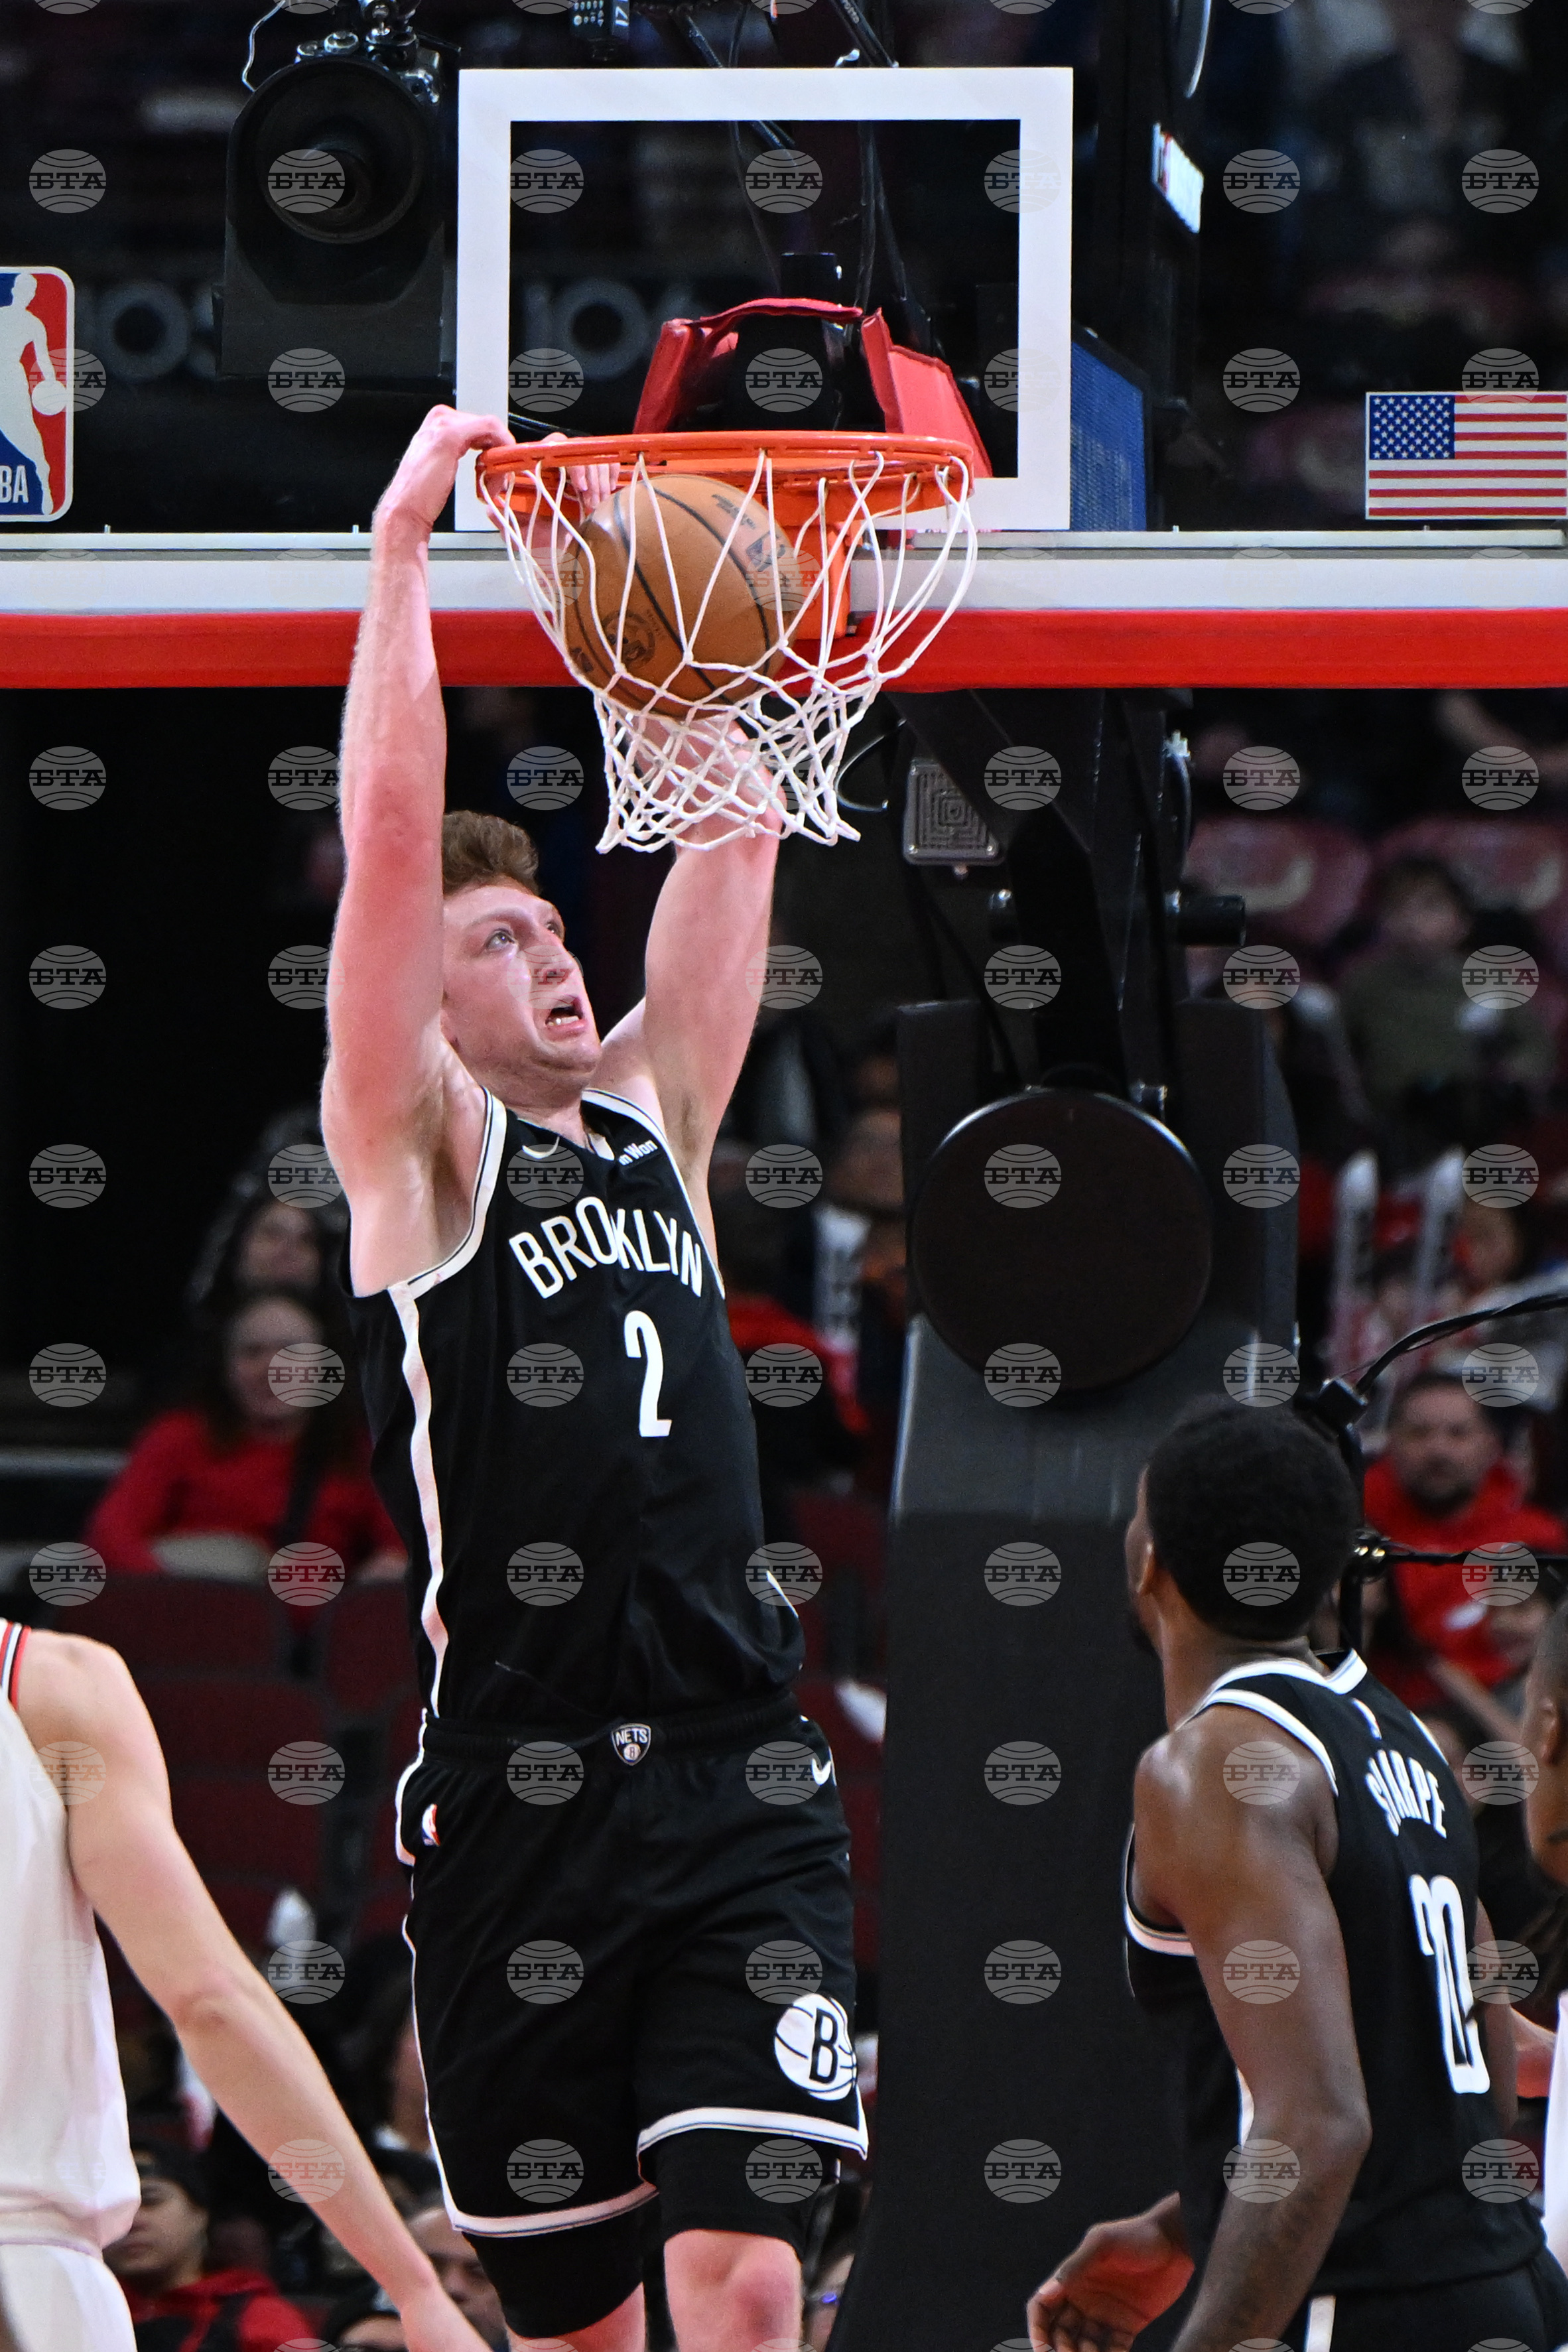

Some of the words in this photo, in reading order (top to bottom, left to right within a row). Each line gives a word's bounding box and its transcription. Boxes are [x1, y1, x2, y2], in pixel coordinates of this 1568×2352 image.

[0, 465, 29, 503] BA
[623, 1140, 658, 1159] Won
[509, 1197, 702, 1299] BROKLYN
[624, 1311, 672, 1437] 2
[616, 1728, 648, 1746] NETS
[1408, 1874, 1490, 2093] 20
[809, 2008, 838, 2083] B
